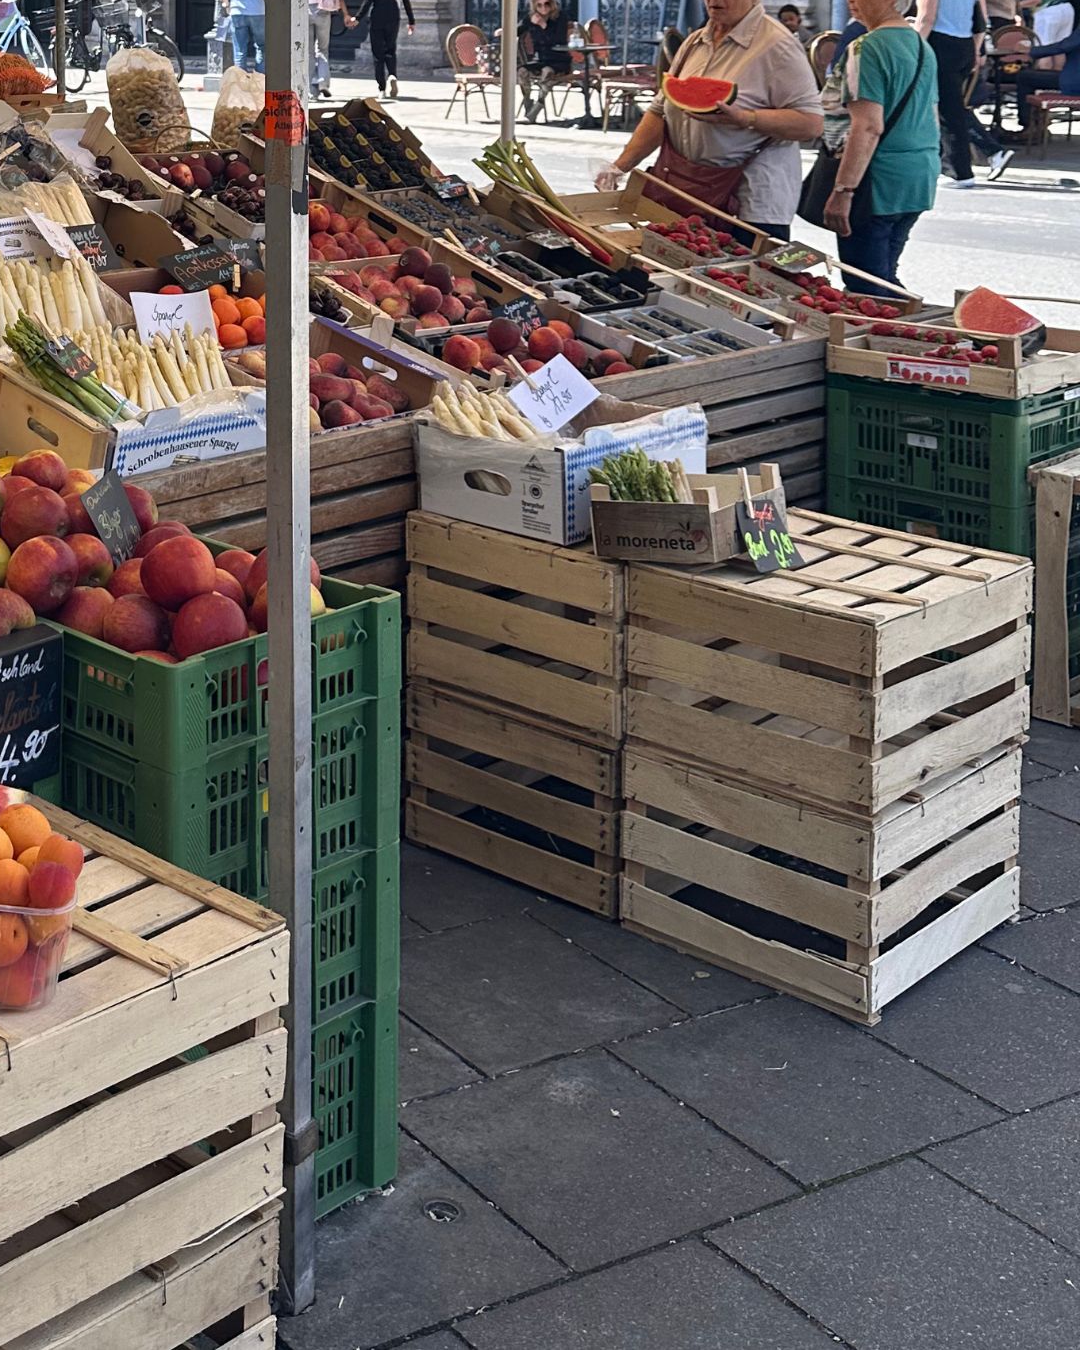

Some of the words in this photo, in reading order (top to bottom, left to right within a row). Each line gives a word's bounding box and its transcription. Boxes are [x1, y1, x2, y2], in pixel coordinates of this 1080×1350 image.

[127, 438, 208, 475] Schrobenhausener
[210, 436, 240, 452] Spargel
[599, 531, 611, 546] la
[617, 534, 696, 551] moreneta
